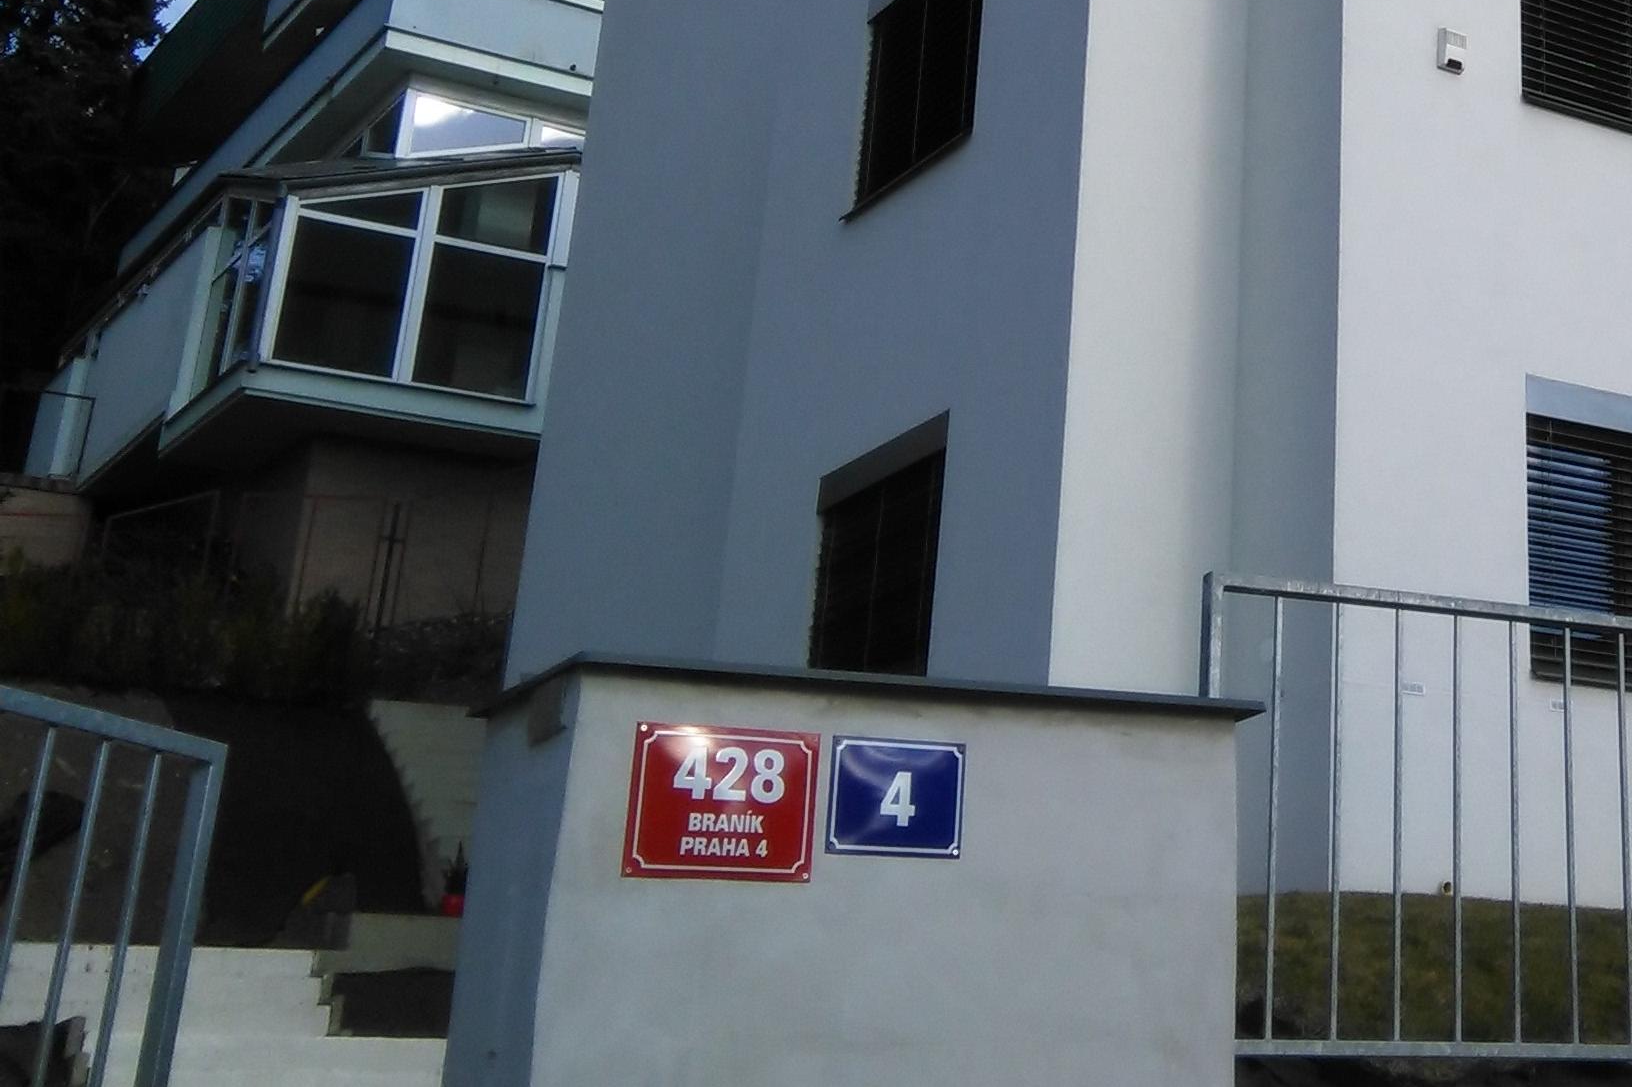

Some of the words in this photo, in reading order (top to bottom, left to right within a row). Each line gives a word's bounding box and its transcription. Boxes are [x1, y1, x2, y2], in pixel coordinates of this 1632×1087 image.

[673, 745, 785, 803] 428
[879, 771, 915, 827] 4
[687, 810, 764, 834] BRANÍK
[679, 837, 749, 857] PRAHA
[755, 839, 768, 858] 4
